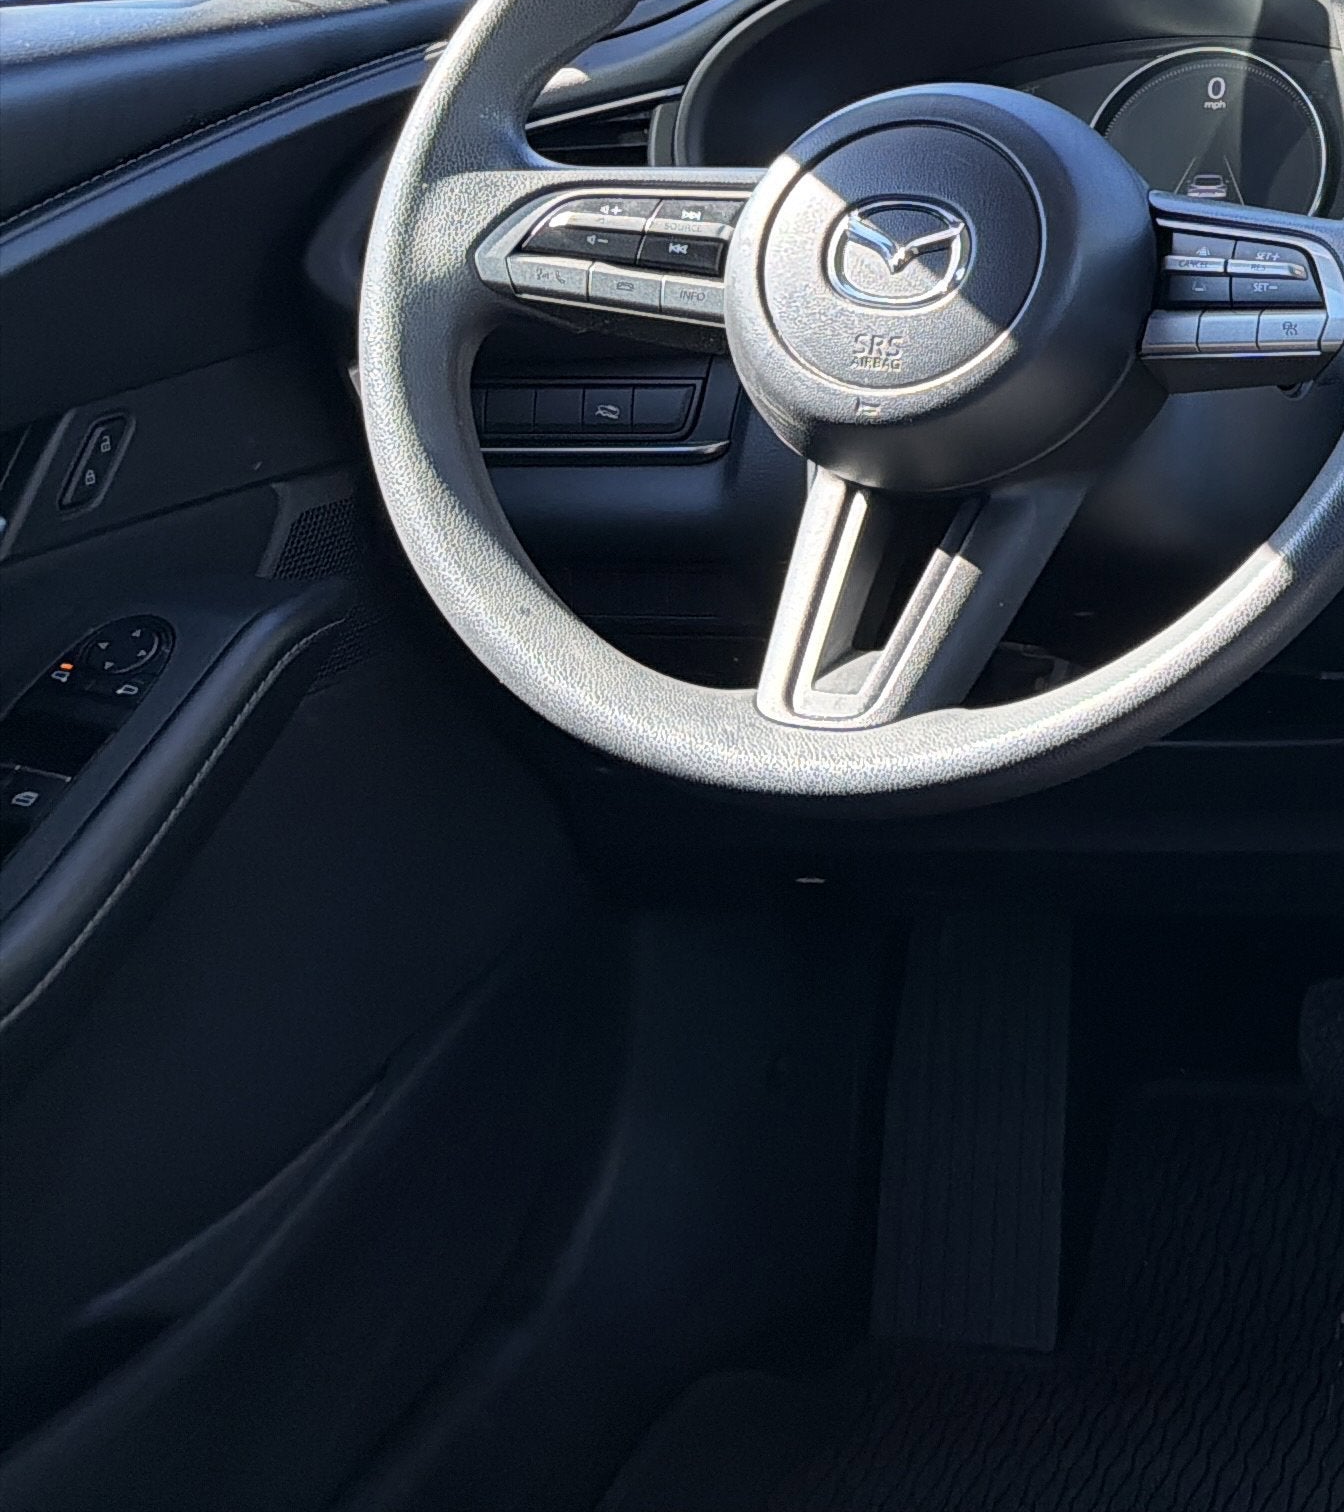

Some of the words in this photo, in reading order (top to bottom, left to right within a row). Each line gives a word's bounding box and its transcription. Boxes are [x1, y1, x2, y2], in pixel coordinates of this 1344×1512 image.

[1207, 76, 1226, 100] 0
[1204, 100, 1226, 110] mph
[664, 221, 703, 233] SOURCE
[679, 289, 706, 302] INFO
[852, 333, 904, 357] SRS
[850, 357, 902, 370] AIRBAG
